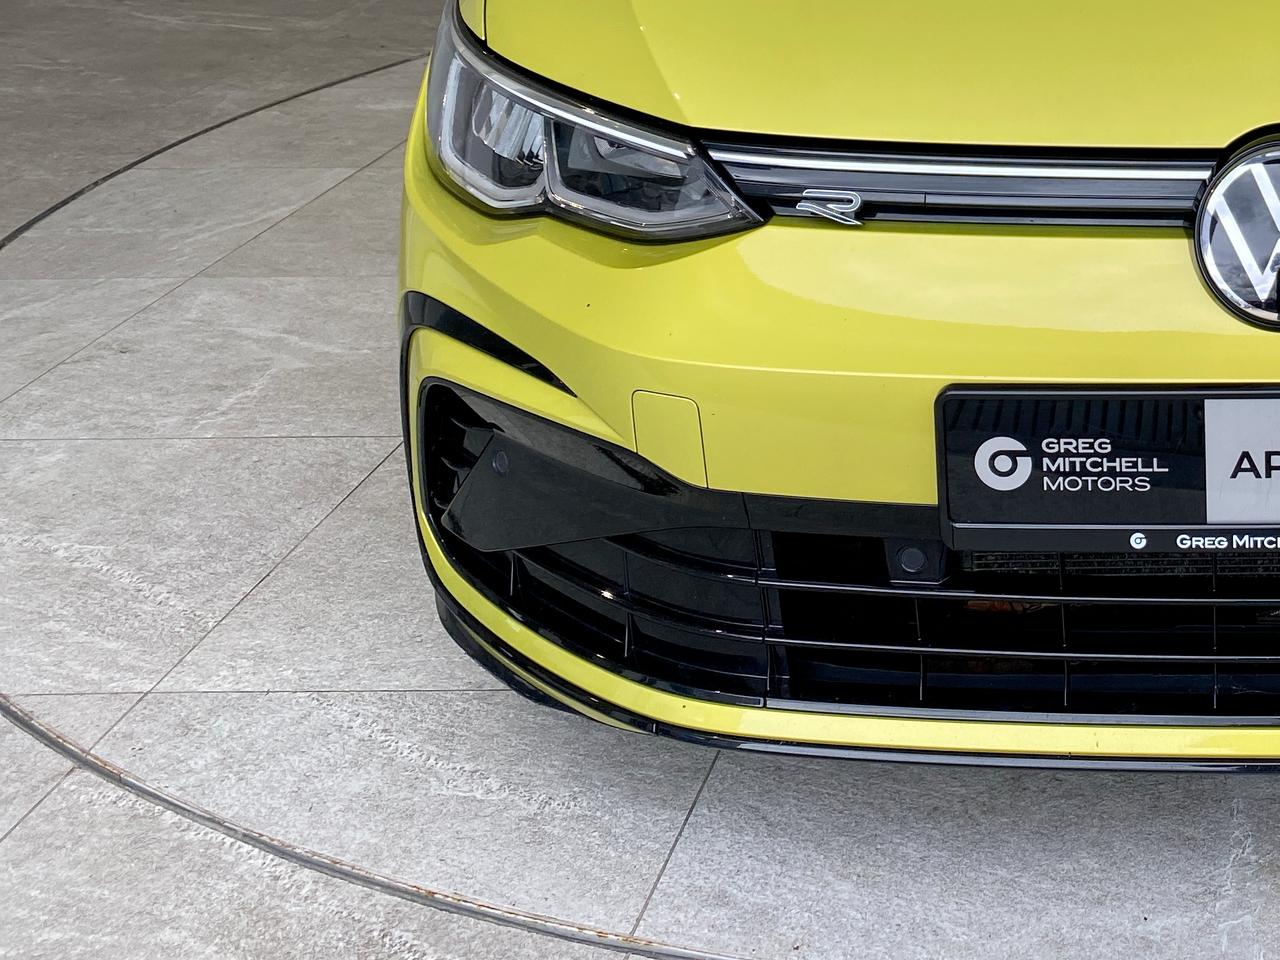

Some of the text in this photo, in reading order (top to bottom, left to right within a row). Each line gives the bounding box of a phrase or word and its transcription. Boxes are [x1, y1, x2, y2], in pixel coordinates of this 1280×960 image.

[1041, 438, 1112, 453] GREG
[1042, 457, 1169, 472] MITCHELL
[1043, 476, 1151, 491] MOTORS
